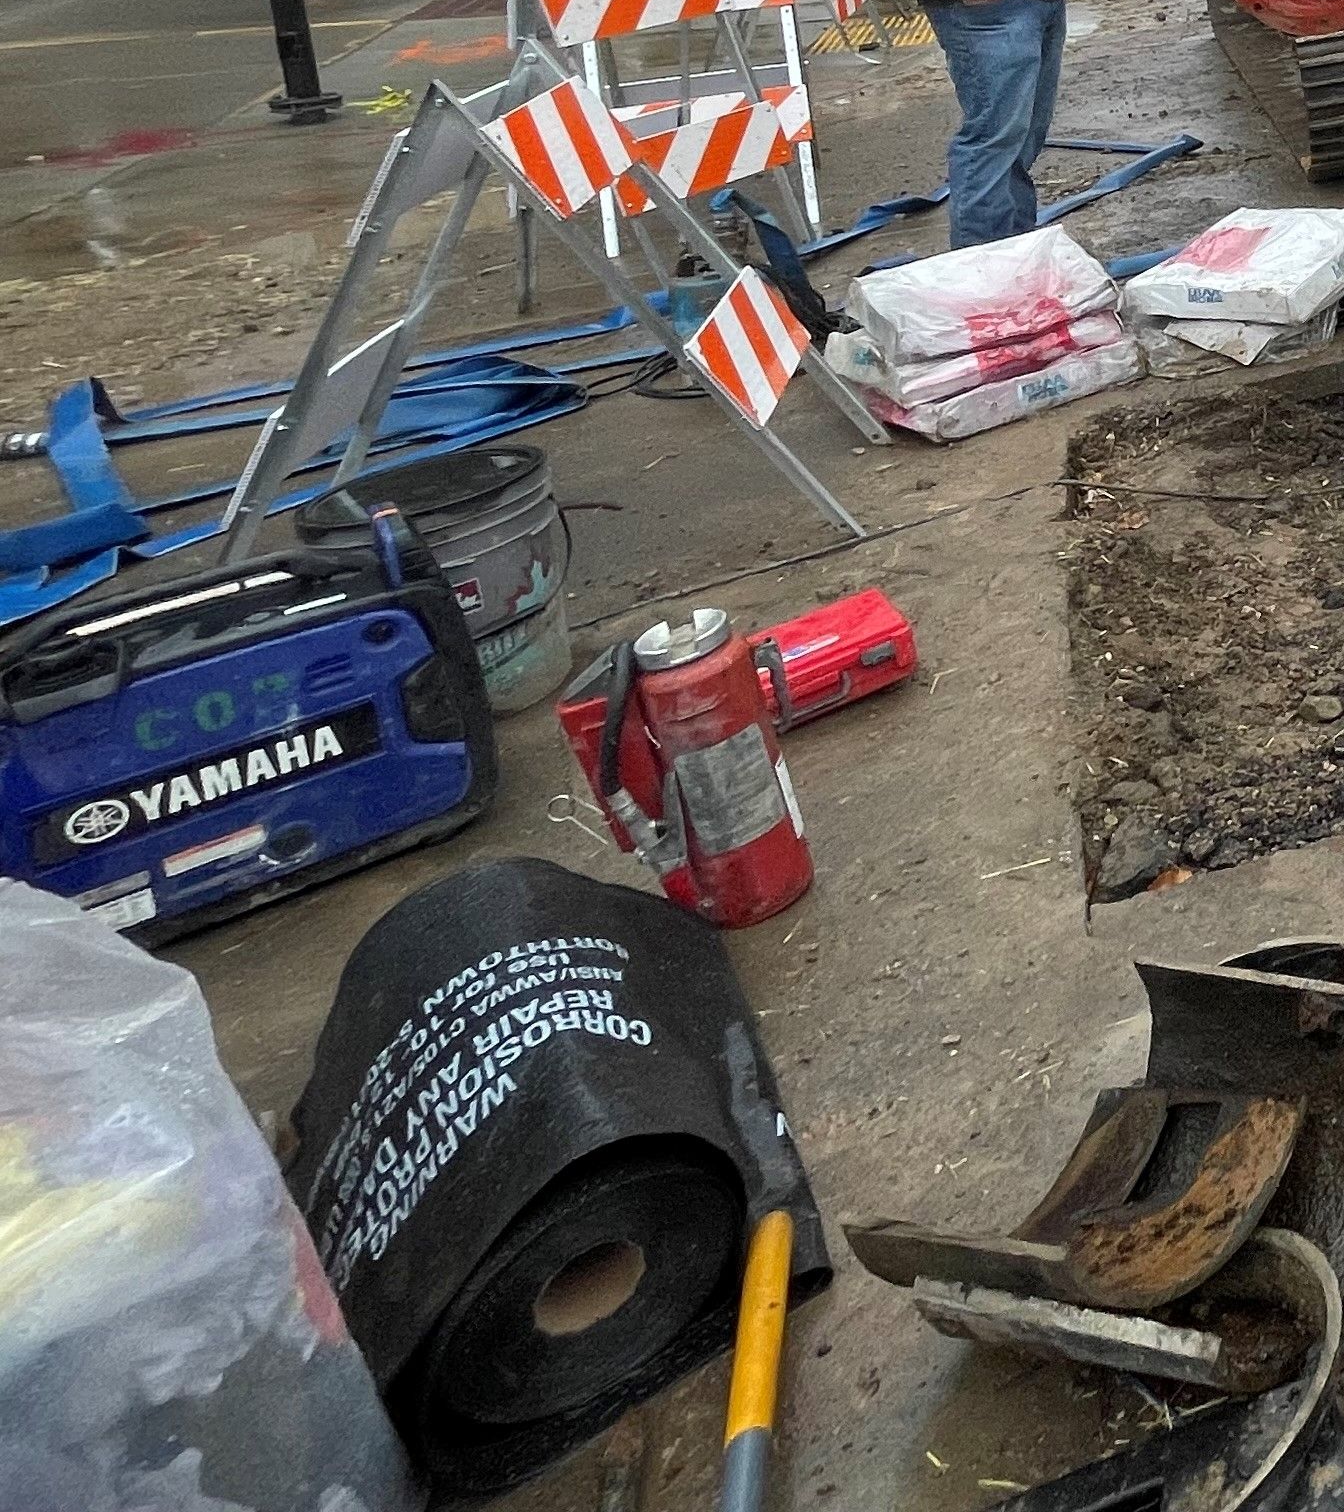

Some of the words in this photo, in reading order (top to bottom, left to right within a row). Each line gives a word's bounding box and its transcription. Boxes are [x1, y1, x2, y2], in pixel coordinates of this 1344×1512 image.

[130, 725, 344, 821] YAMAHA
[422, 937, 630, 1015] NORTHTOWN
[451, 972, 497, 1012] for
[470, 967, 623, 1016] ANSI/AWWA
[472, 990, 614, 1056] REPAIR
[406, 1051, 462, 1142] ANY
[434, 1009, 652, 1128] CORROSION
[370, 1072, 518, 1261] WARNING
